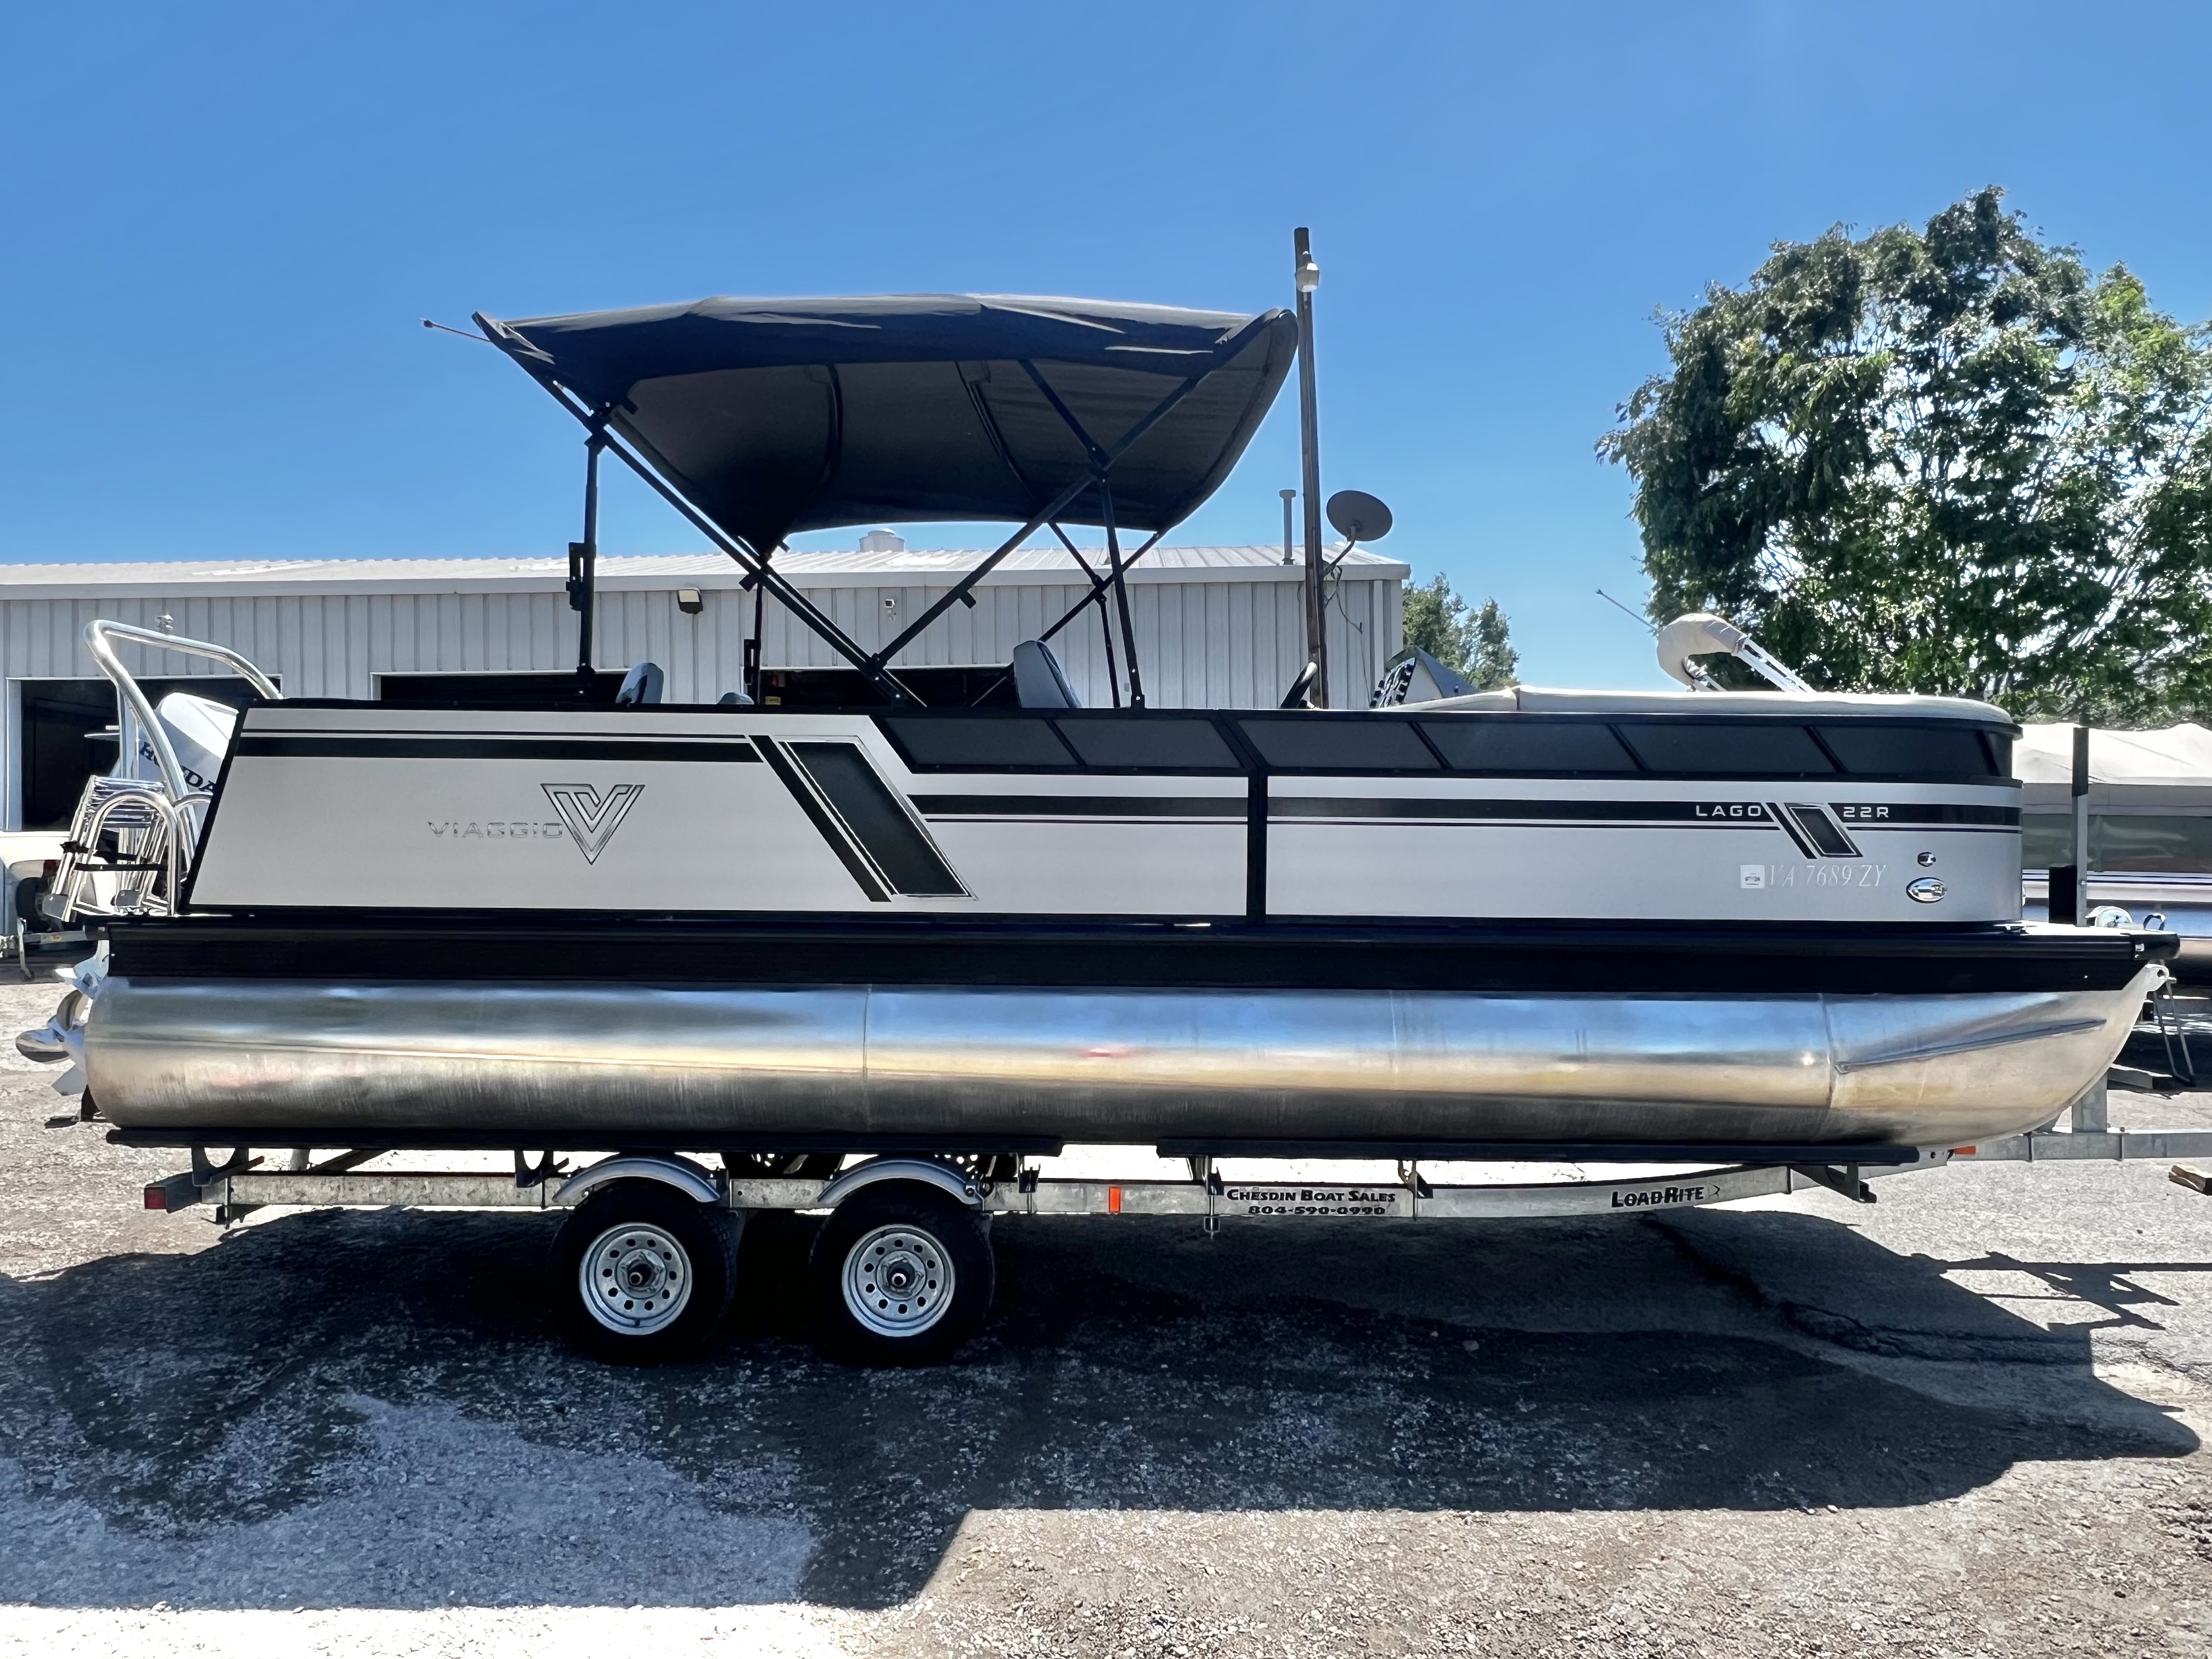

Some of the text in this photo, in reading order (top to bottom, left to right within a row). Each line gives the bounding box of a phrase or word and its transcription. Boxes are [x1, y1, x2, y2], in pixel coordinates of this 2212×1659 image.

[1696, 805, 1889, 818] LAGO 22R
[428, 822, 563, 839] VIAGGIO
[1858, 865, 1887, 887] ZY
[1300, 1189, 1345, 1201] BOAT
[1248, 1206, 1386, 1215] 804-590-0990
